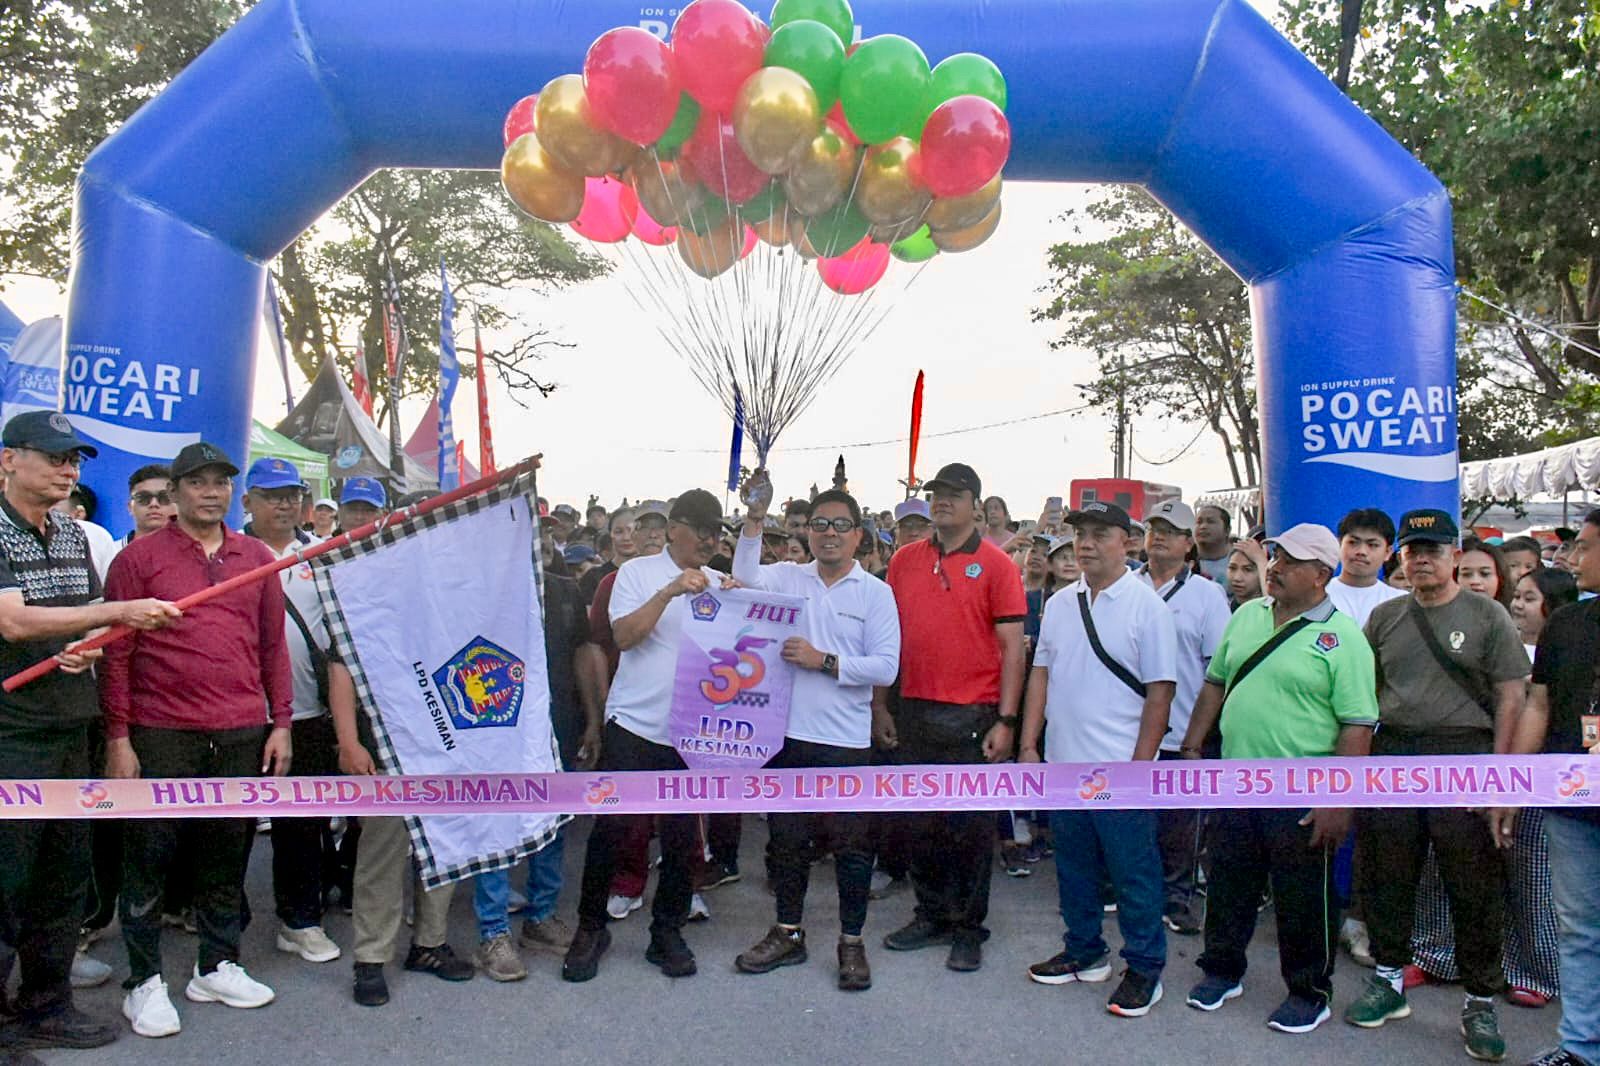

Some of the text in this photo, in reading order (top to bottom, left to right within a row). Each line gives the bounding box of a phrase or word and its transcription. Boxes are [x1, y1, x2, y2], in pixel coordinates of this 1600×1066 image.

[640, 8, 664, 17] ION
[1301, 376, 1396, 392] ION SUPPLY DRINK
[1302, 386, 1453, 423] POCARI
[1303, 416, 1447, 452] SWEAT
[747, 602, 800, 625] HUT
[700, 634, 772, 705] 35
[413, 661, 456, 751] LPD KESIMAN
[699, 716, 755, 742] LPD
[679, 737, 769, 760] KESIMAN
[152, 777, 548, 804] HUT 35 LPD KESIMAN
[657, 771, 1046, 800] HUT 35 LPD KESIMAN
[1151, 766, 1533, 795] HUT 35 LPD KESIMAN
